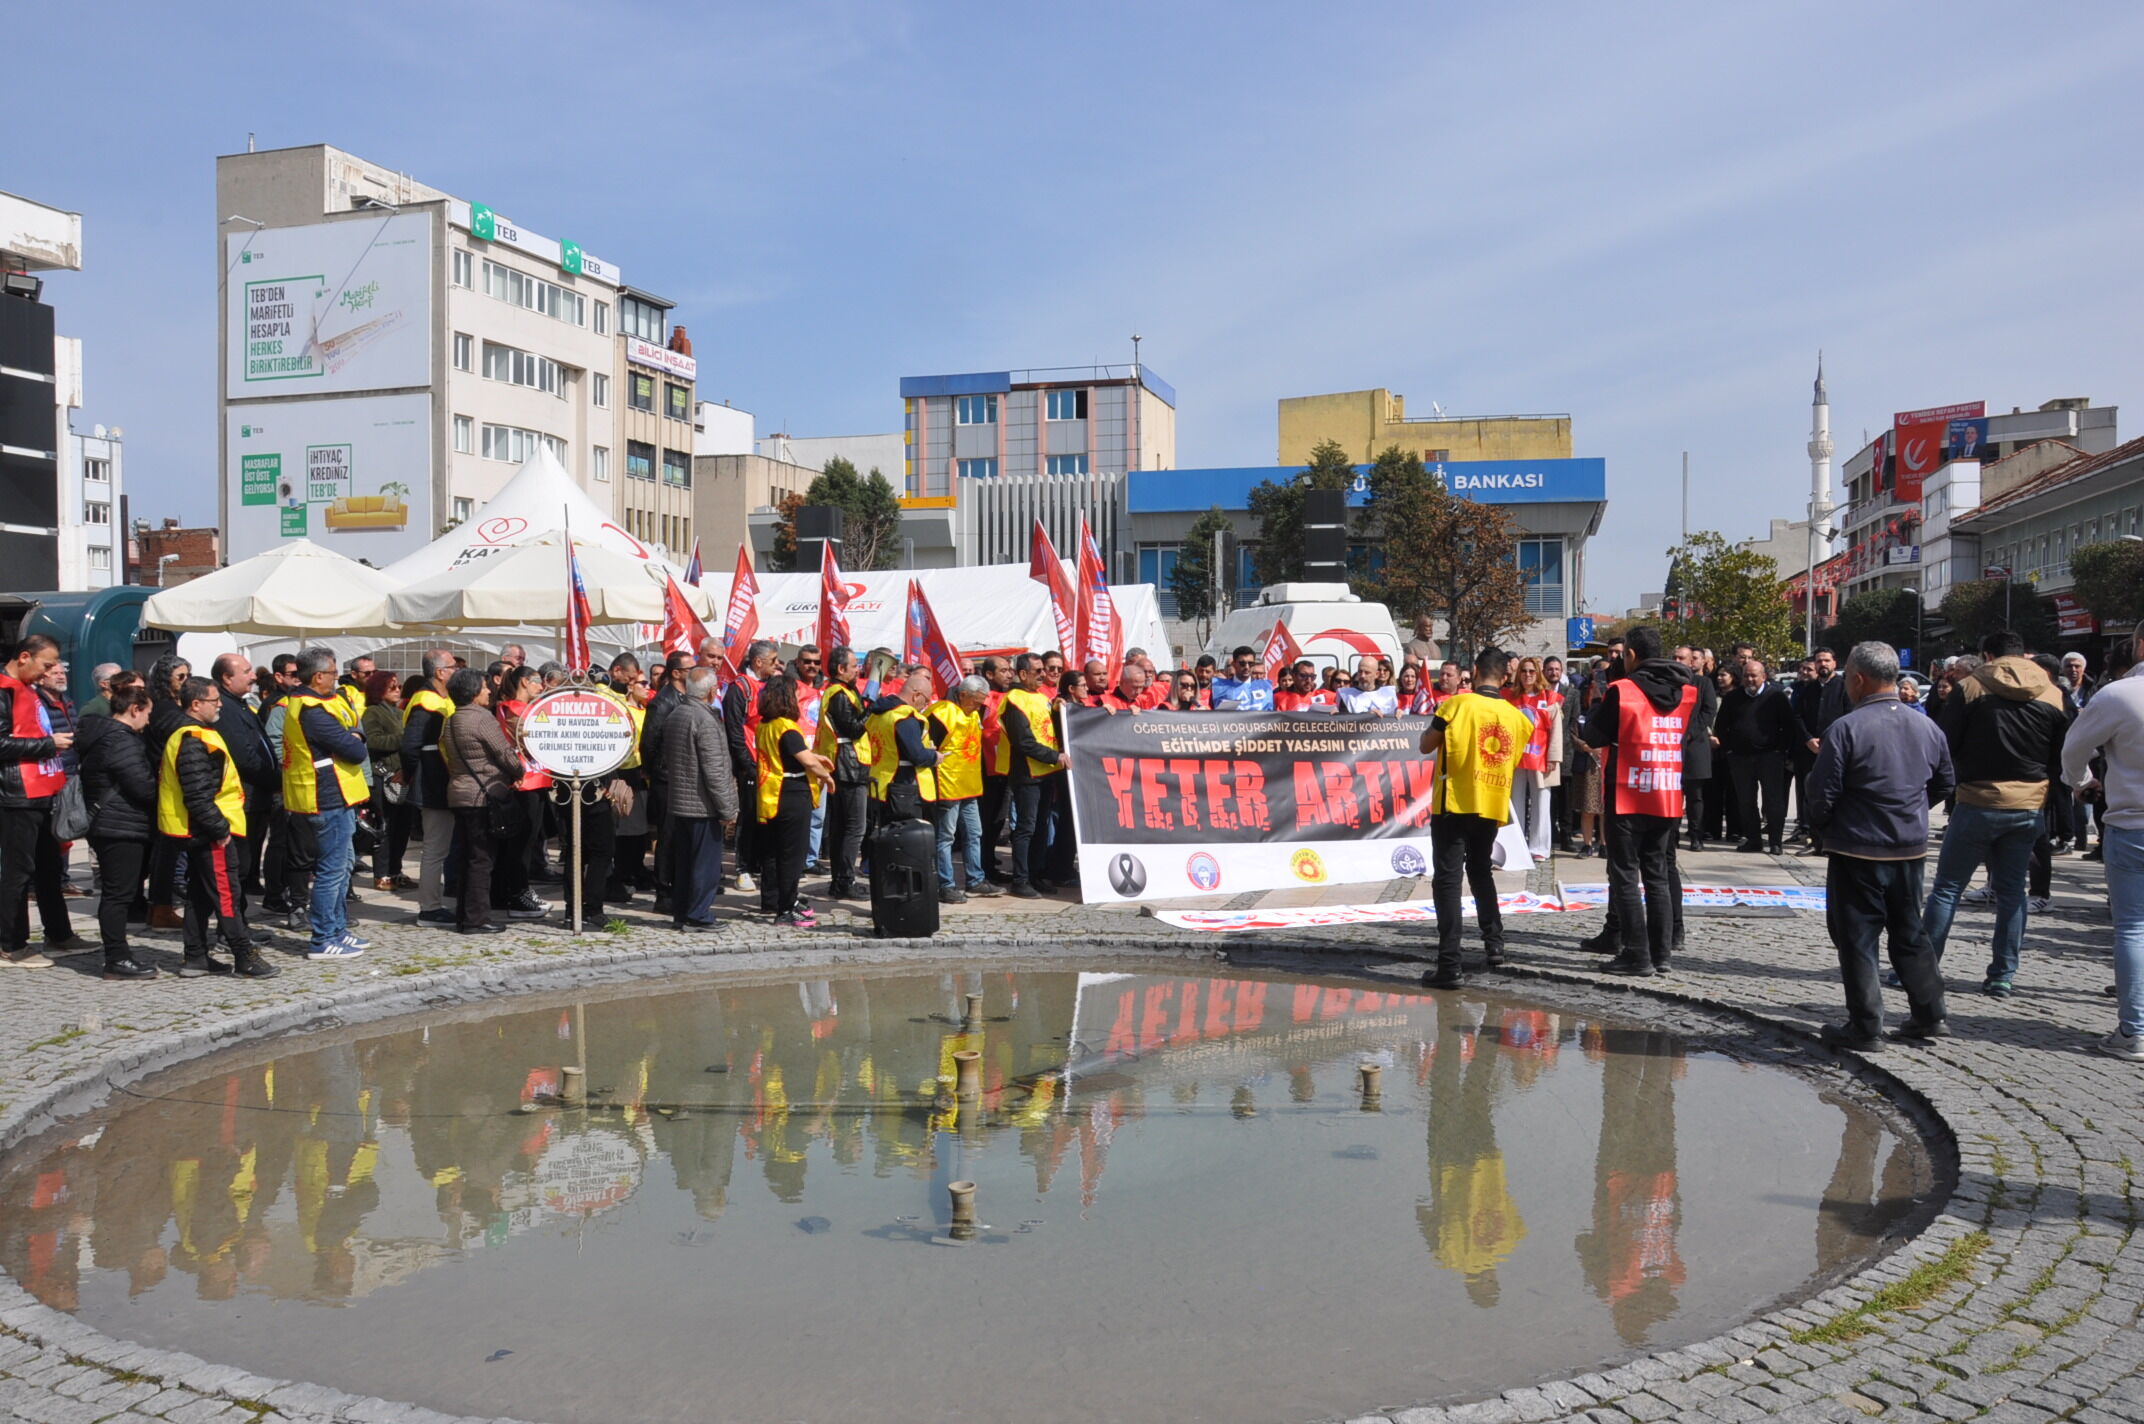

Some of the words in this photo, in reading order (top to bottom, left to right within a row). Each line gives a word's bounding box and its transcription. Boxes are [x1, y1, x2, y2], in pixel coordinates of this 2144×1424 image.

[495, 223, 518, 242] TEB
[582, 258, 601, 275] TEB
[250, 286, 285, 304] TEB'DEN
[250, 304, 294, 321] MARİFETLİ
[250, 322, 291, 339] HESAP'LA
[250, 340, 283, 356] HERKES
[250, 355, 313, 374] BİRİKTİREBİLİR
[310, 449, 343, 465] İHTİYAÇ
[310, 465, 349, 481] KREDİNİZ
[1454, 473, 1544, 490] BANKASI
[310, 483, 337, 498] TEB'DE
[459, 548, 501, 559] KA
[1901, 649, 1907, 658] P
[551, 699, 598, 715] DİKKAT
[601, 702, 606, 715] !
[557, 718, 566, 727] BU
[568, 718, 600, 727] HAVUZDA
[1133, 720, 1220, 735] ÖĞRETMENLERİ
[1223, 721, 1291, 734] KORURSANIZ
[1292, 720, 1357, 733] GELECEĞİNİZİ
[1359, 721, 1426, 733] KORURSUNUZ
[1652, 716, 1683, 729] EMEK
[528, 730, 558, 739] ELEKTRİK
[560, 730, 581, 739] AKIMI
[539, 742, 573, 752] GİRİLMESİ
[574, 742, 606, 752] TEHLİKELİ
[608, 743, 616, 752] VE
[1161, 736, 1231, 753] EĞİTİMDE
[1234, 736, 1283, 756] ŞİDDET
[1285, 738, 1345, 752] YASASINI
[1348, 737, 1410, 754] ÇIKARTIN
[563, 756, 594, 764] YASAKTIR
[1102, 757, 1271, 832] YETER
[1293, 759, 1435, 831] ARTIK
